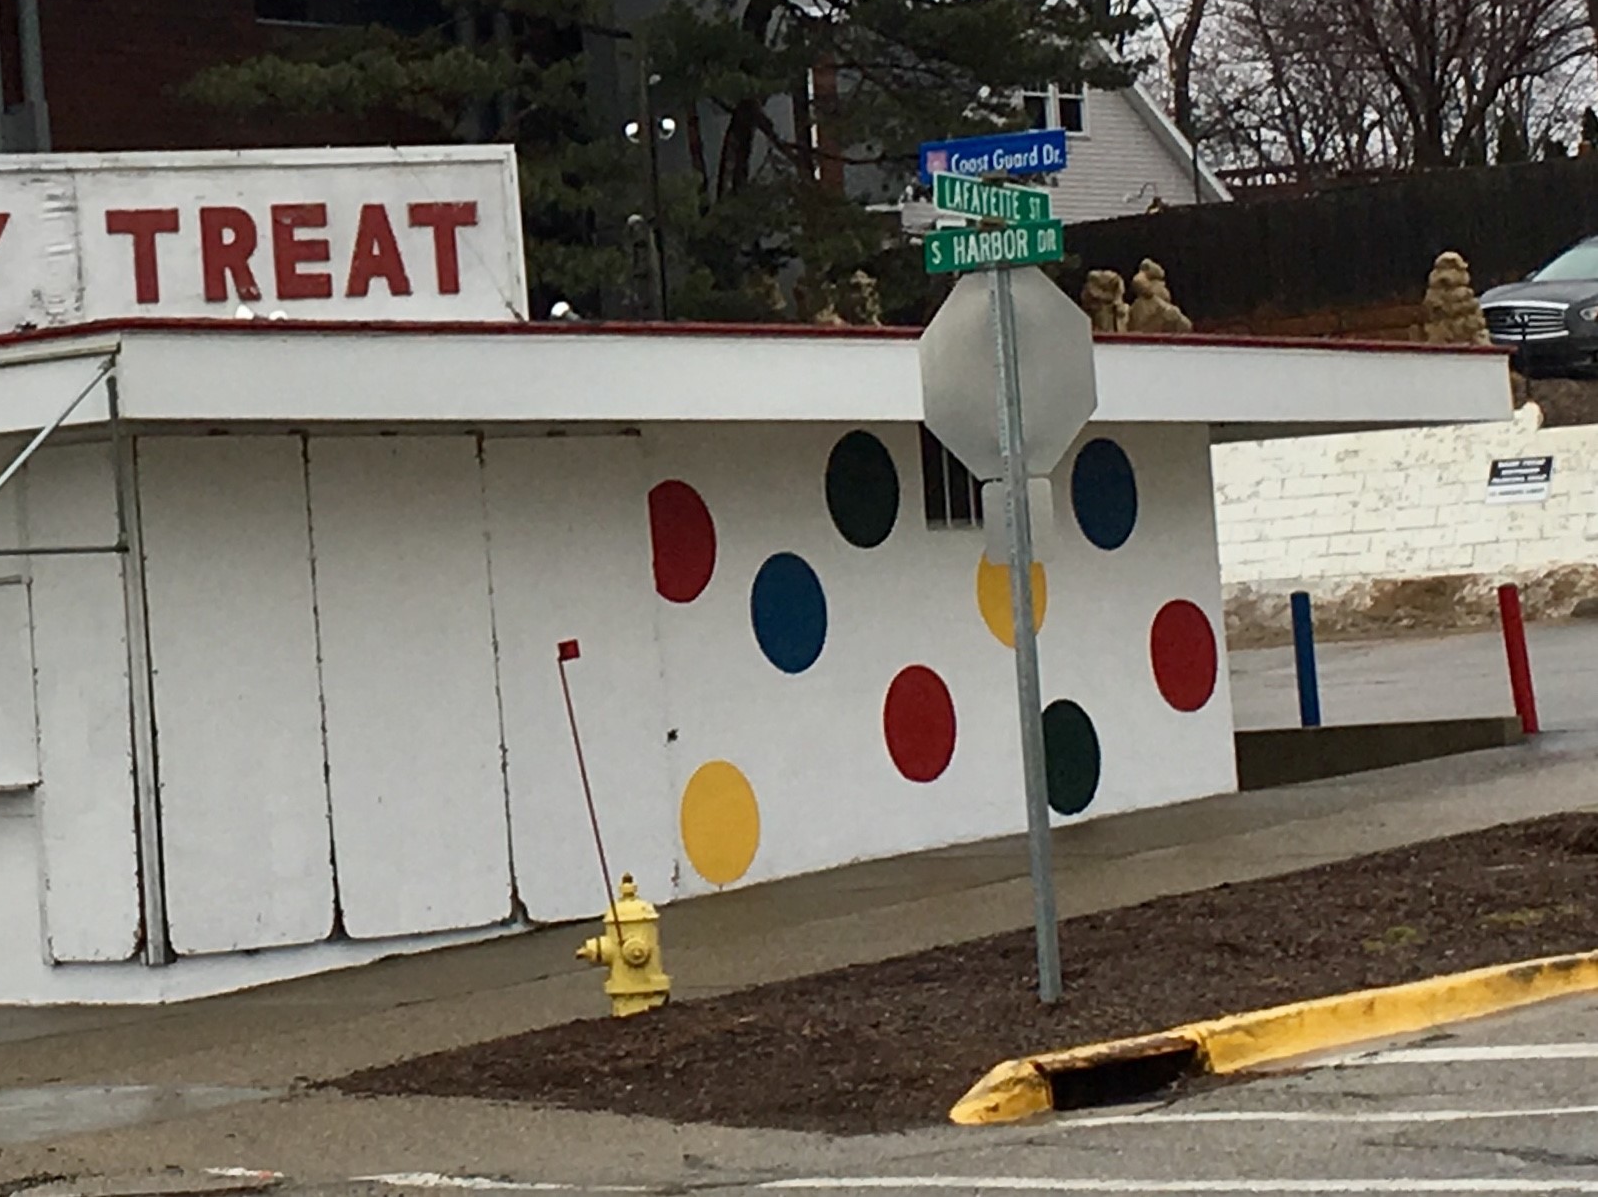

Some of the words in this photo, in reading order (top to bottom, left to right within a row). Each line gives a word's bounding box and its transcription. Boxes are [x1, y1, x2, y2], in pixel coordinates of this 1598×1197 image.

[952, 153, 989, 174] Coast
[992, 144, 1039, 170] Guard
[1042, 143, 1064, 165] Dr.
[945, 178, 1021, 220] LAFAYETTE
[1029, 196, 1042, 221] ST
[105, 201, 480, 305] TREAT
[931, 240, 943, 265] S
[953, 228, 1029, 266] HARBOR
[1037, 228, 1057, 253] DR
